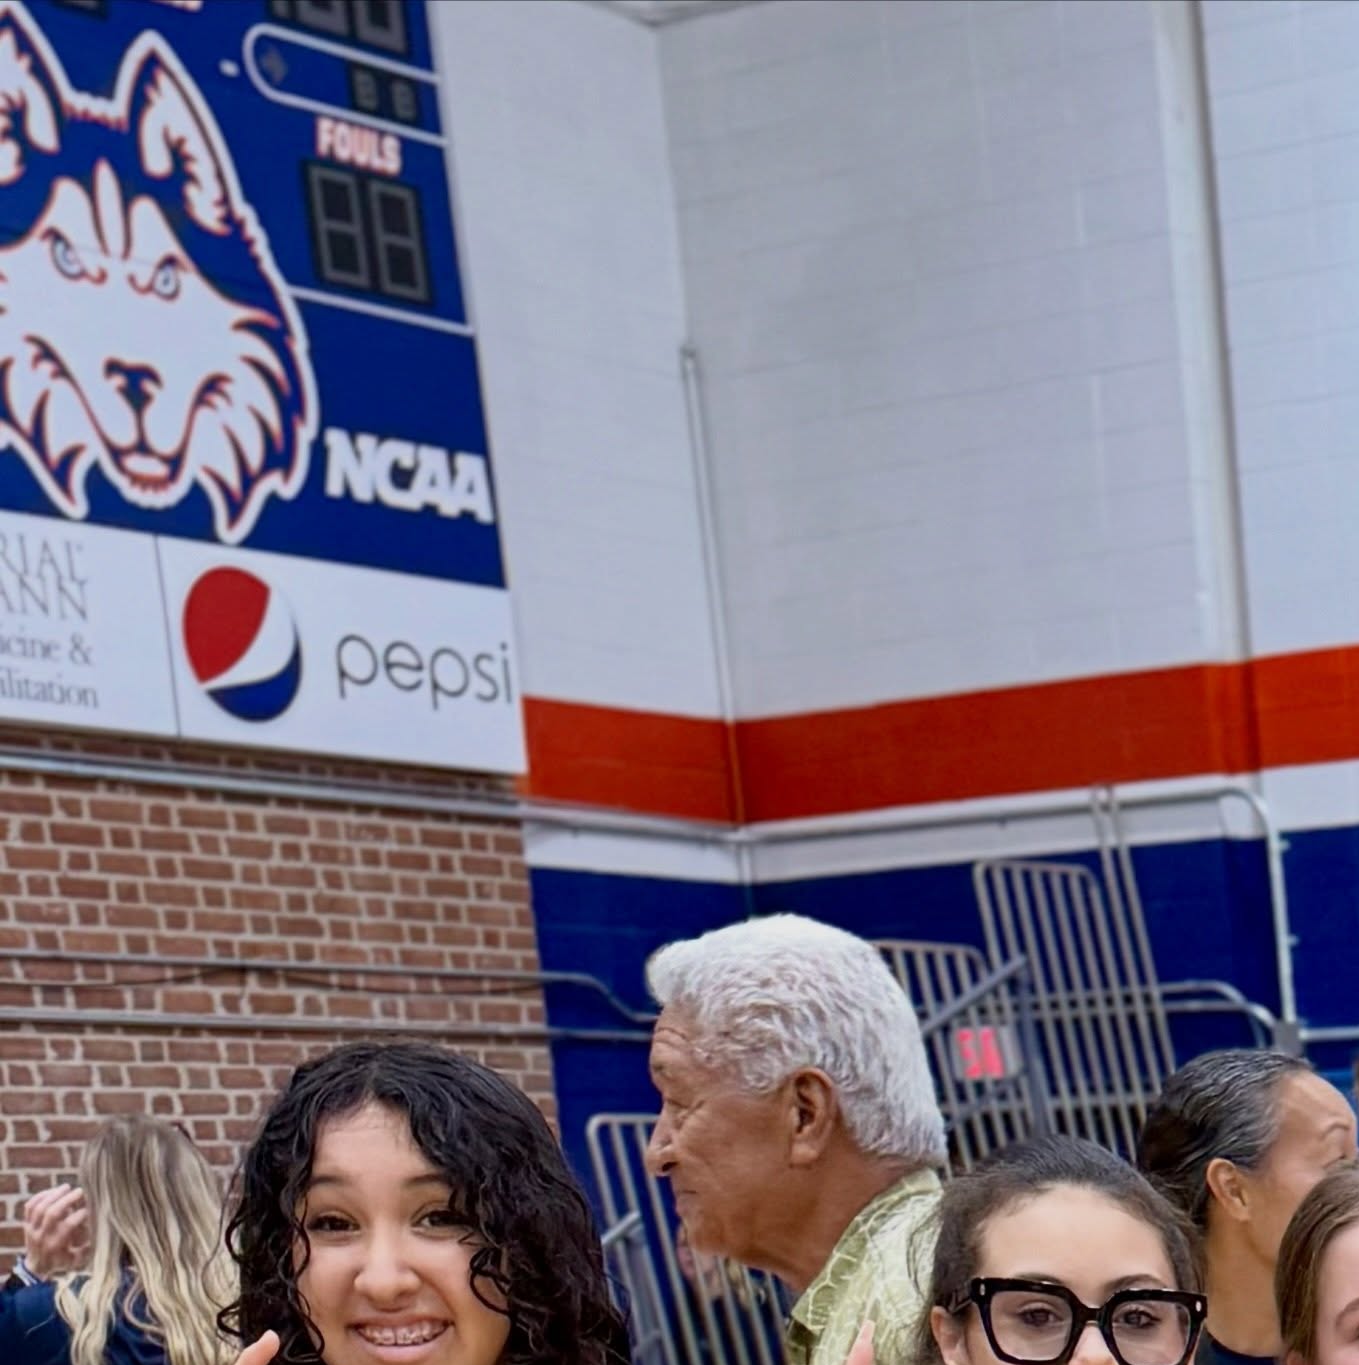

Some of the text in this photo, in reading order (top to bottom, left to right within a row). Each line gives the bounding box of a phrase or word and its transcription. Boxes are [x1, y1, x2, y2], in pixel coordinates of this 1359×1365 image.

[316, 115, 402, 177] FOULS
[325, 427, 495, 523] NCAA
[69, 632, 94, 666] &
[336, 634, 513, 710] pepsi
